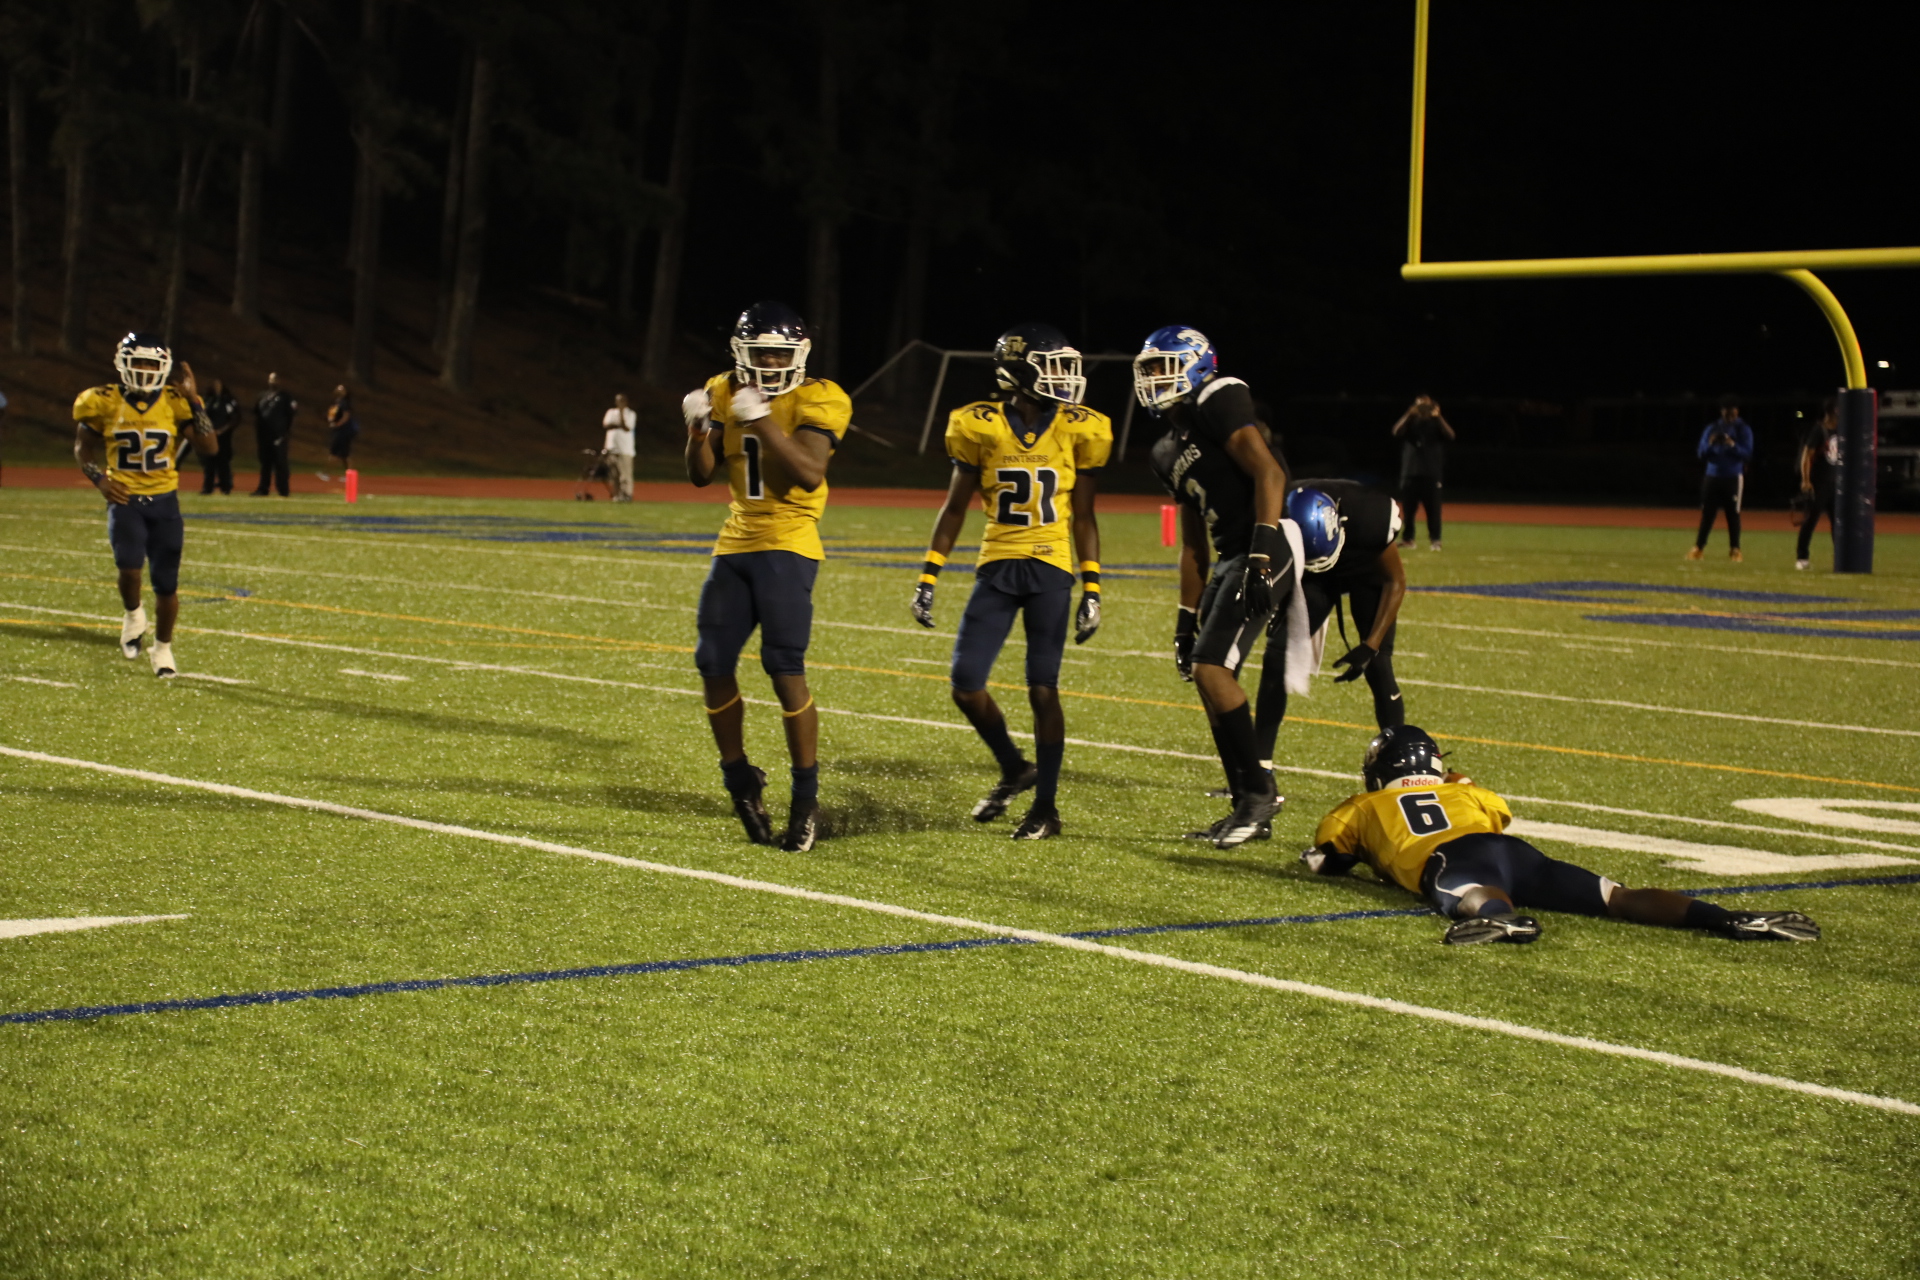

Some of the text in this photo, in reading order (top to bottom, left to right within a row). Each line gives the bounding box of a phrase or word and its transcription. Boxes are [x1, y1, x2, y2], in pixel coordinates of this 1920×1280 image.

[111, 428, 171, 473] 22
[742, 434, 765, 499] 1
[1003, 454, 1048, 463] PANTHERS
[995, 467, 1059, 527] 21
[1401, 777, 1439, 788] Riddell
[1397, 790, 1452, 837] 6
